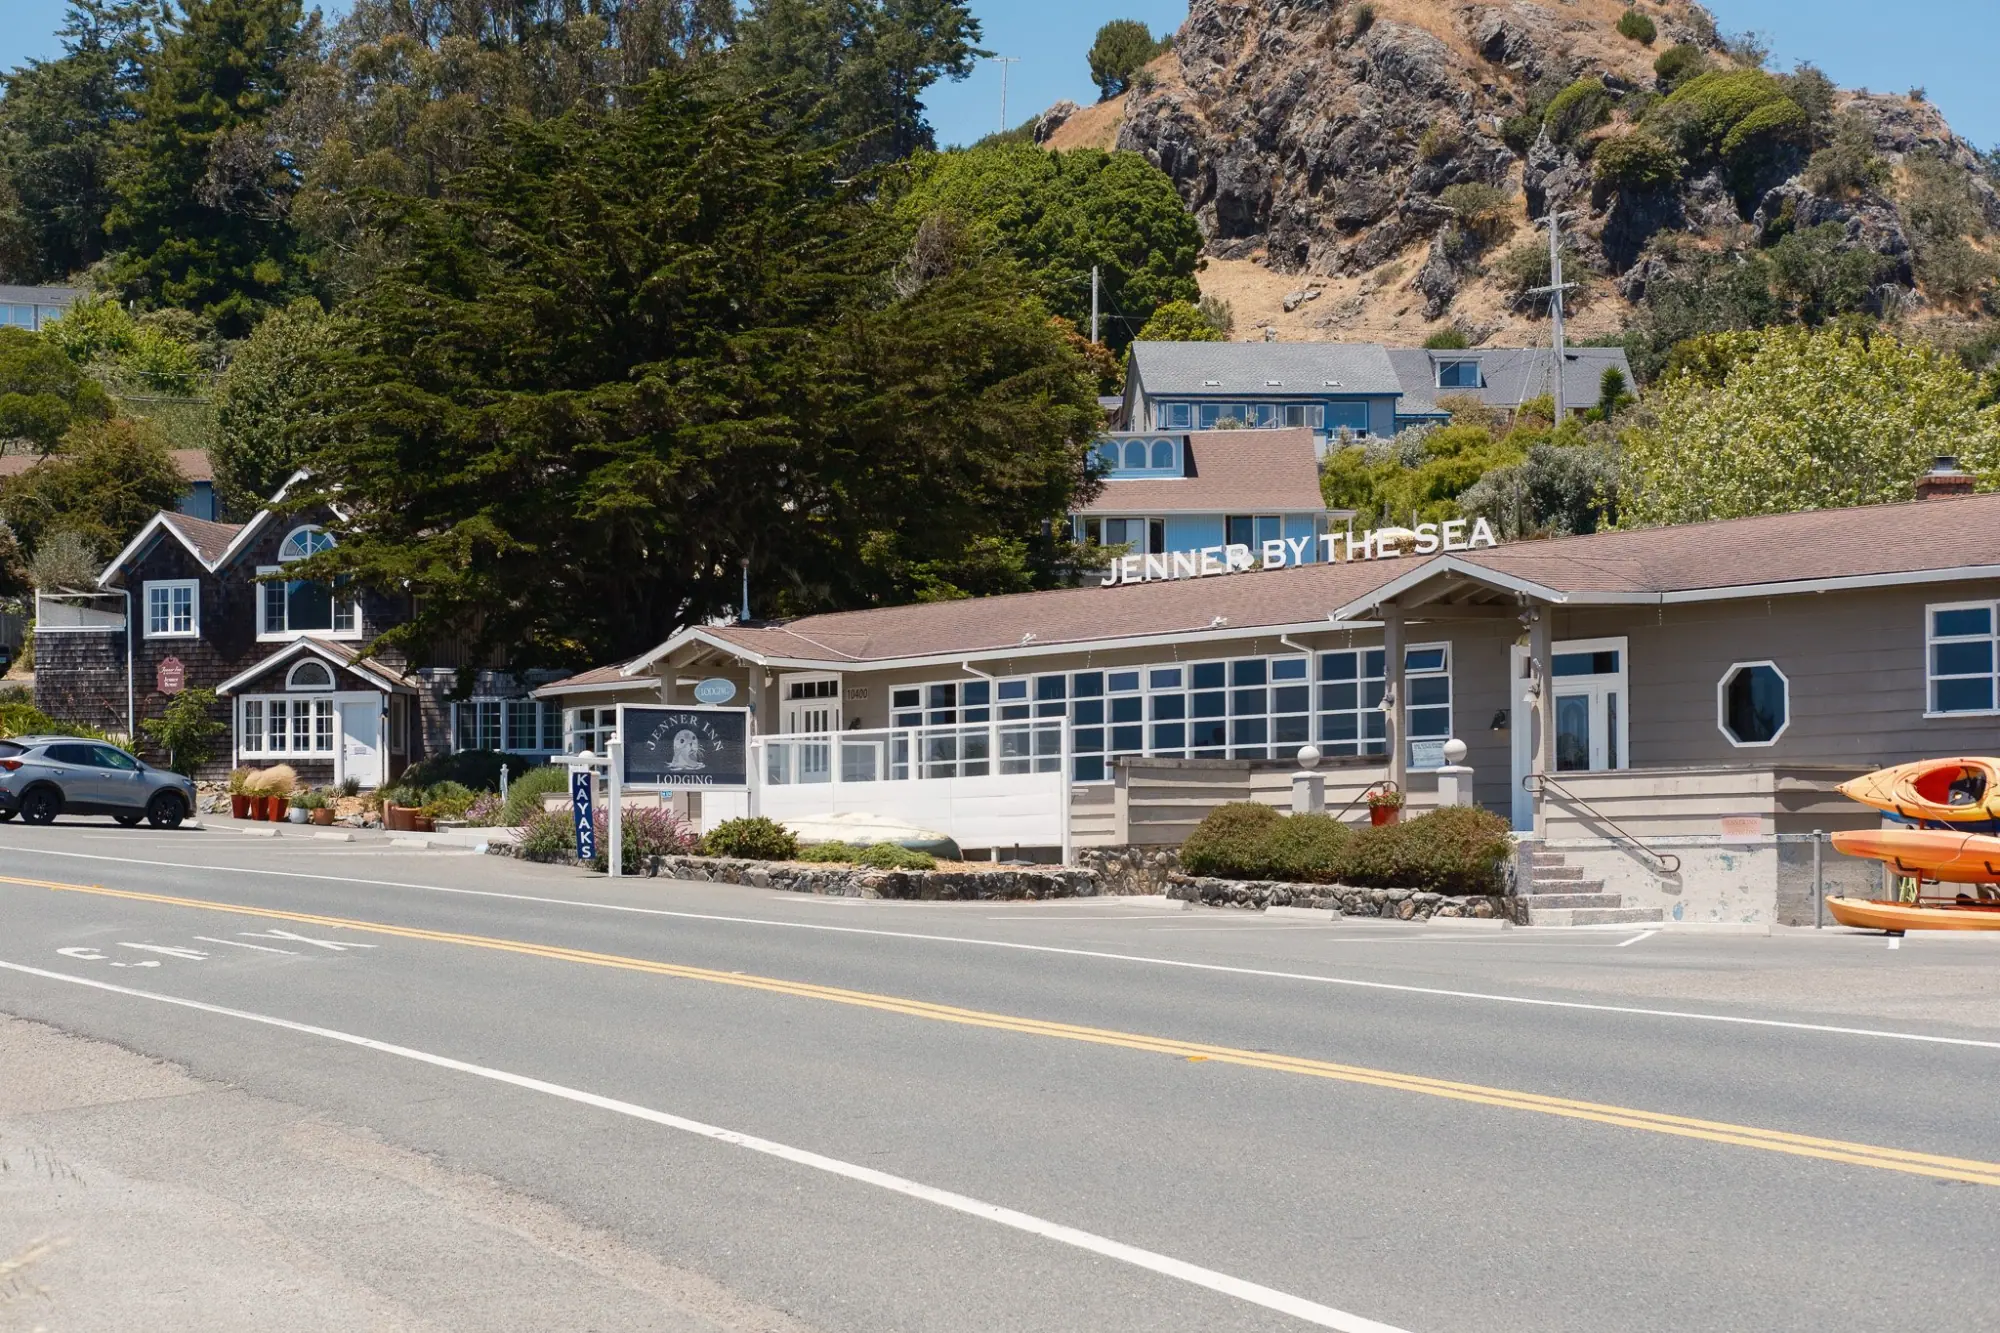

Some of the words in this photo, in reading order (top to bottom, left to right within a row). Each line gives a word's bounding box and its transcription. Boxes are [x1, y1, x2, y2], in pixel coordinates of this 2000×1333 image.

[1101, 543, 1250, 586] JENNER
[1263, 536, 1311, 569] BY
[1320, 527, 1400, 563] THE
[1414, 517, 1497, 554] SEA
[847, 688, 868, 700] 10400
[647, 714, 698, 751] JENNER
[702, 722, 724, 751] INN
[656, 774, 713, 785] LODGING
[576, 773, 593, 859] KAYAKS
